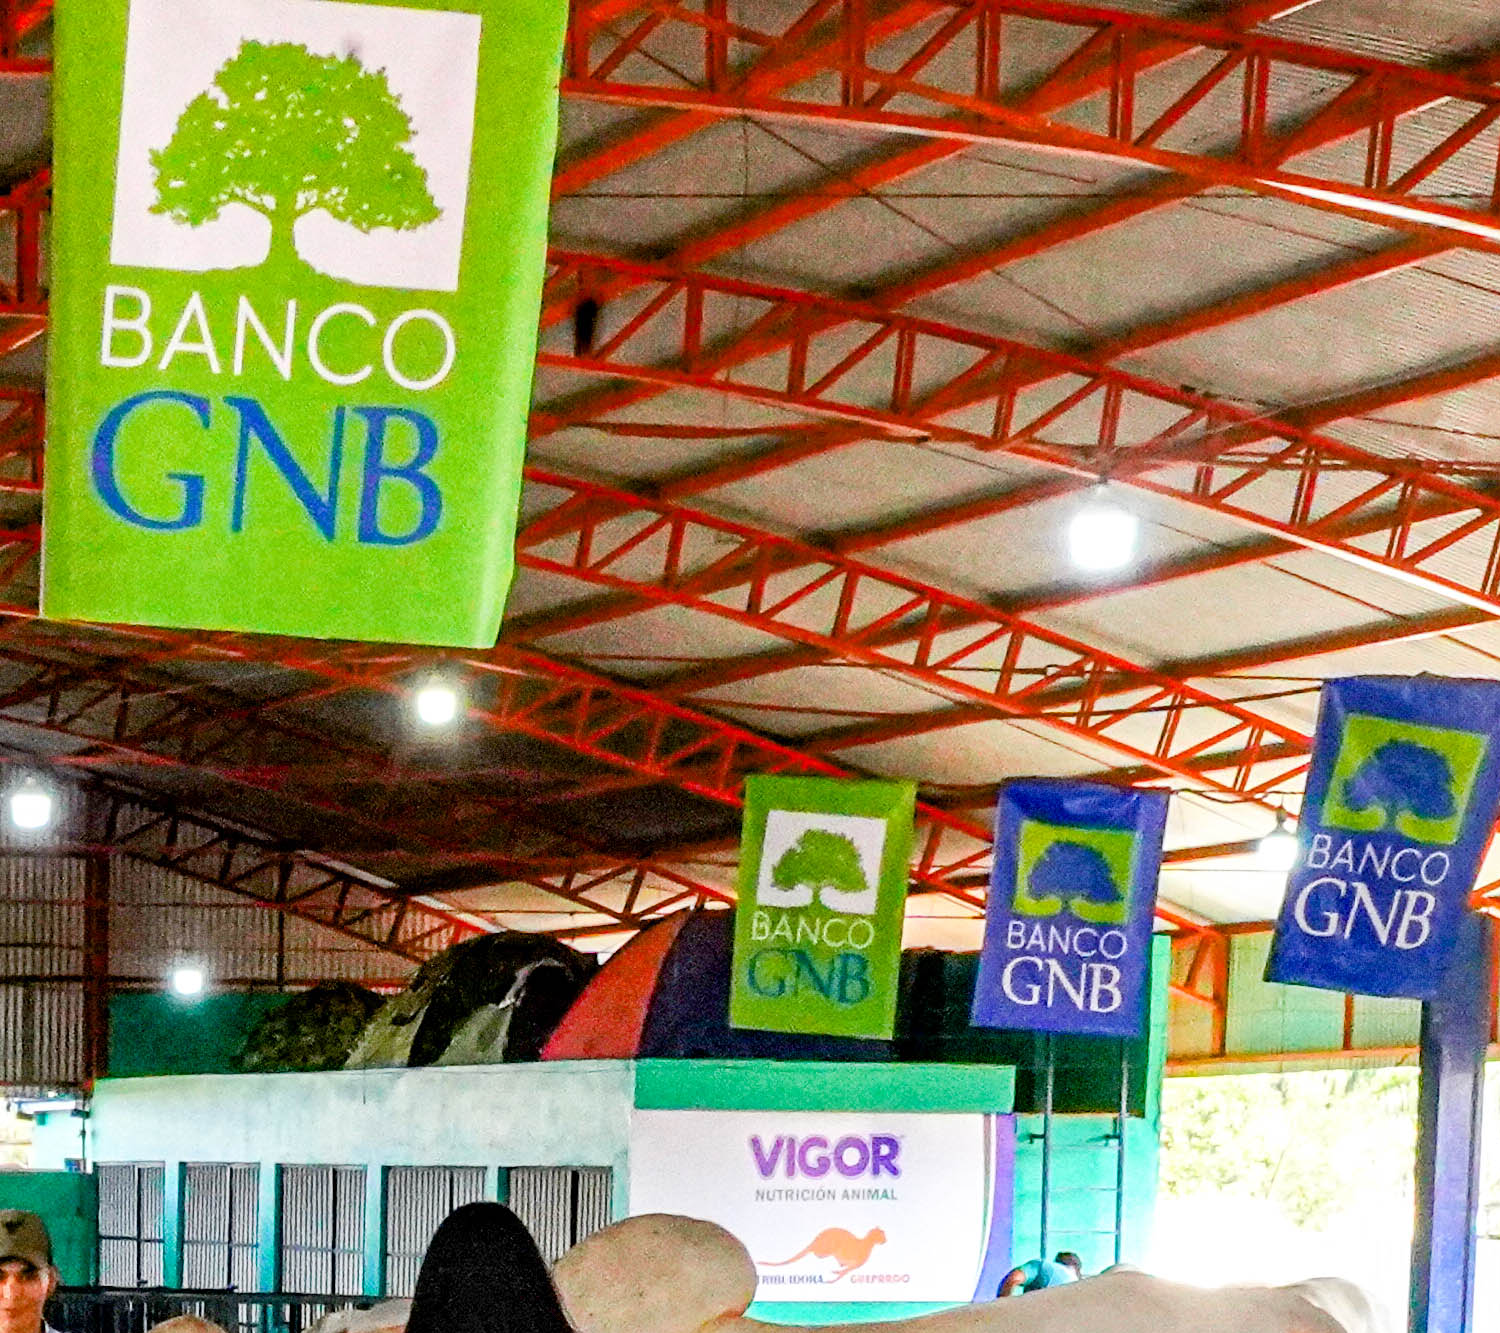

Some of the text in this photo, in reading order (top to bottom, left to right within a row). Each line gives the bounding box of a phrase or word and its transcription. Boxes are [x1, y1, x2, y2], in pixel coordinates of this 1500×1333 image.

[101, 286, 457, 391] BANCO
[90, 390, 443, 547] GNB
[1307, 833, 1450, 886] BANCO
[751, 911, 875, 949] BANCO
[1006, 920, 1129, 959] BANCO
[1294, 877, 1436, 950] GNB
[748, 949, 871, 1004] GNB
[1002, 956, 1122, 1013] GNB
[751, 1135, 901, 1178] VIGOR
[755, 1186, 898, 1202] NUTRICIÓN ANIMAL
